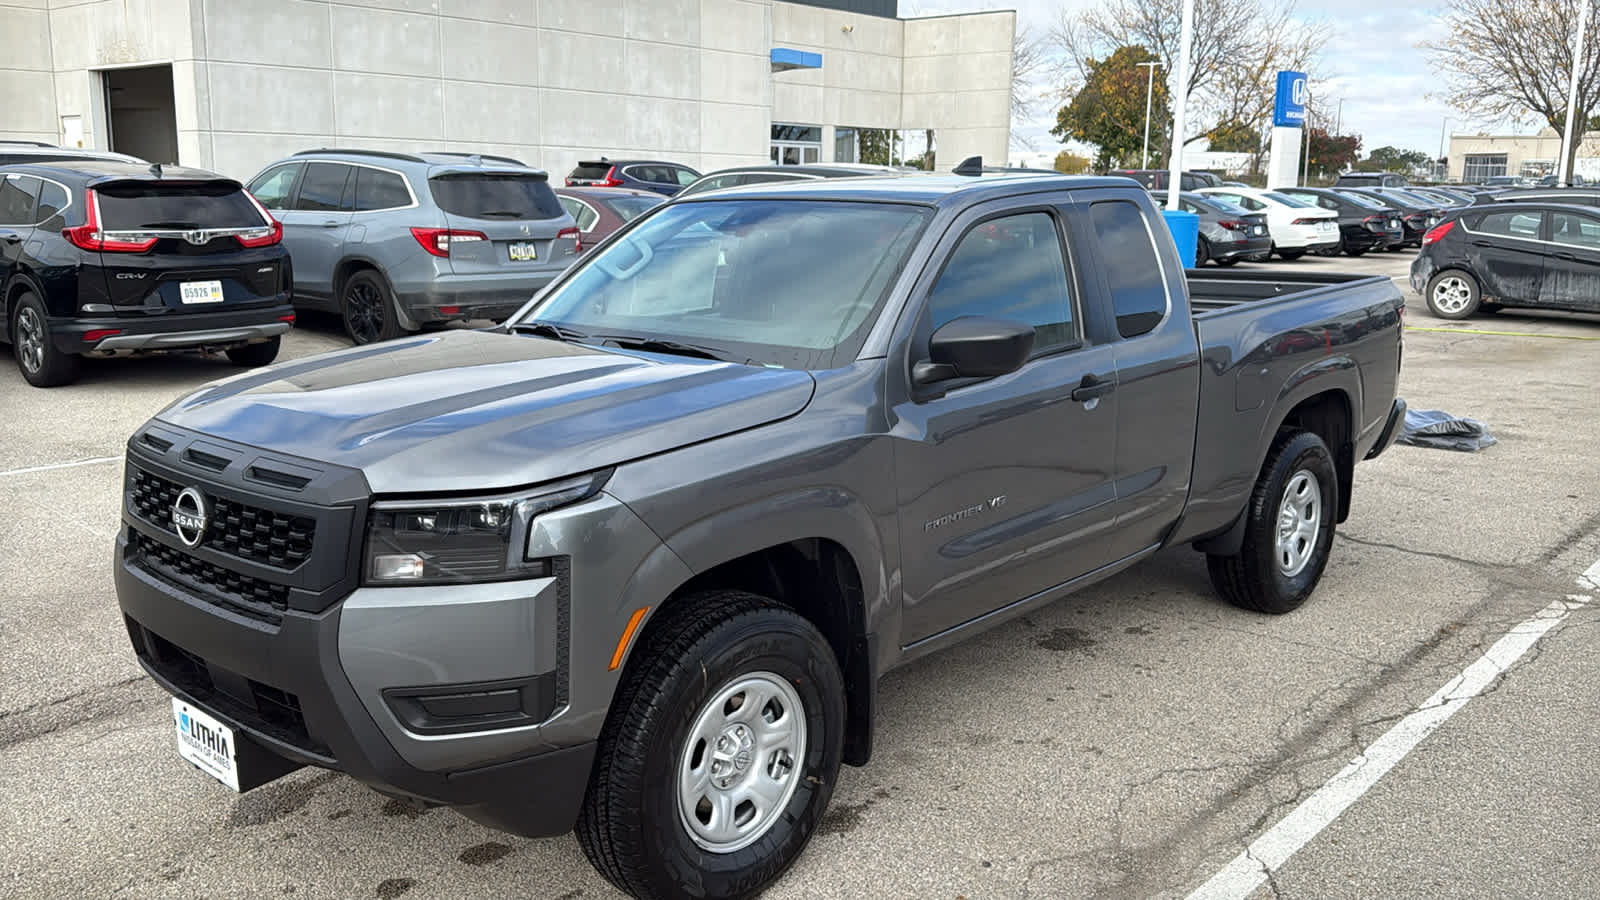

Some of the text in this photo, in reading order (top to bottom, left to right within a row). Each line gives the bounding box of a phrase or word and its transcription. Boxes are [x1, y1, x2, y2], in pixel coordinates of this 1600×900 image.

[171, 510, 205, 529] ISSAN
[922, 504, 984, 534] FRONTIER
[190, 717, 230, 760] LITHIA
